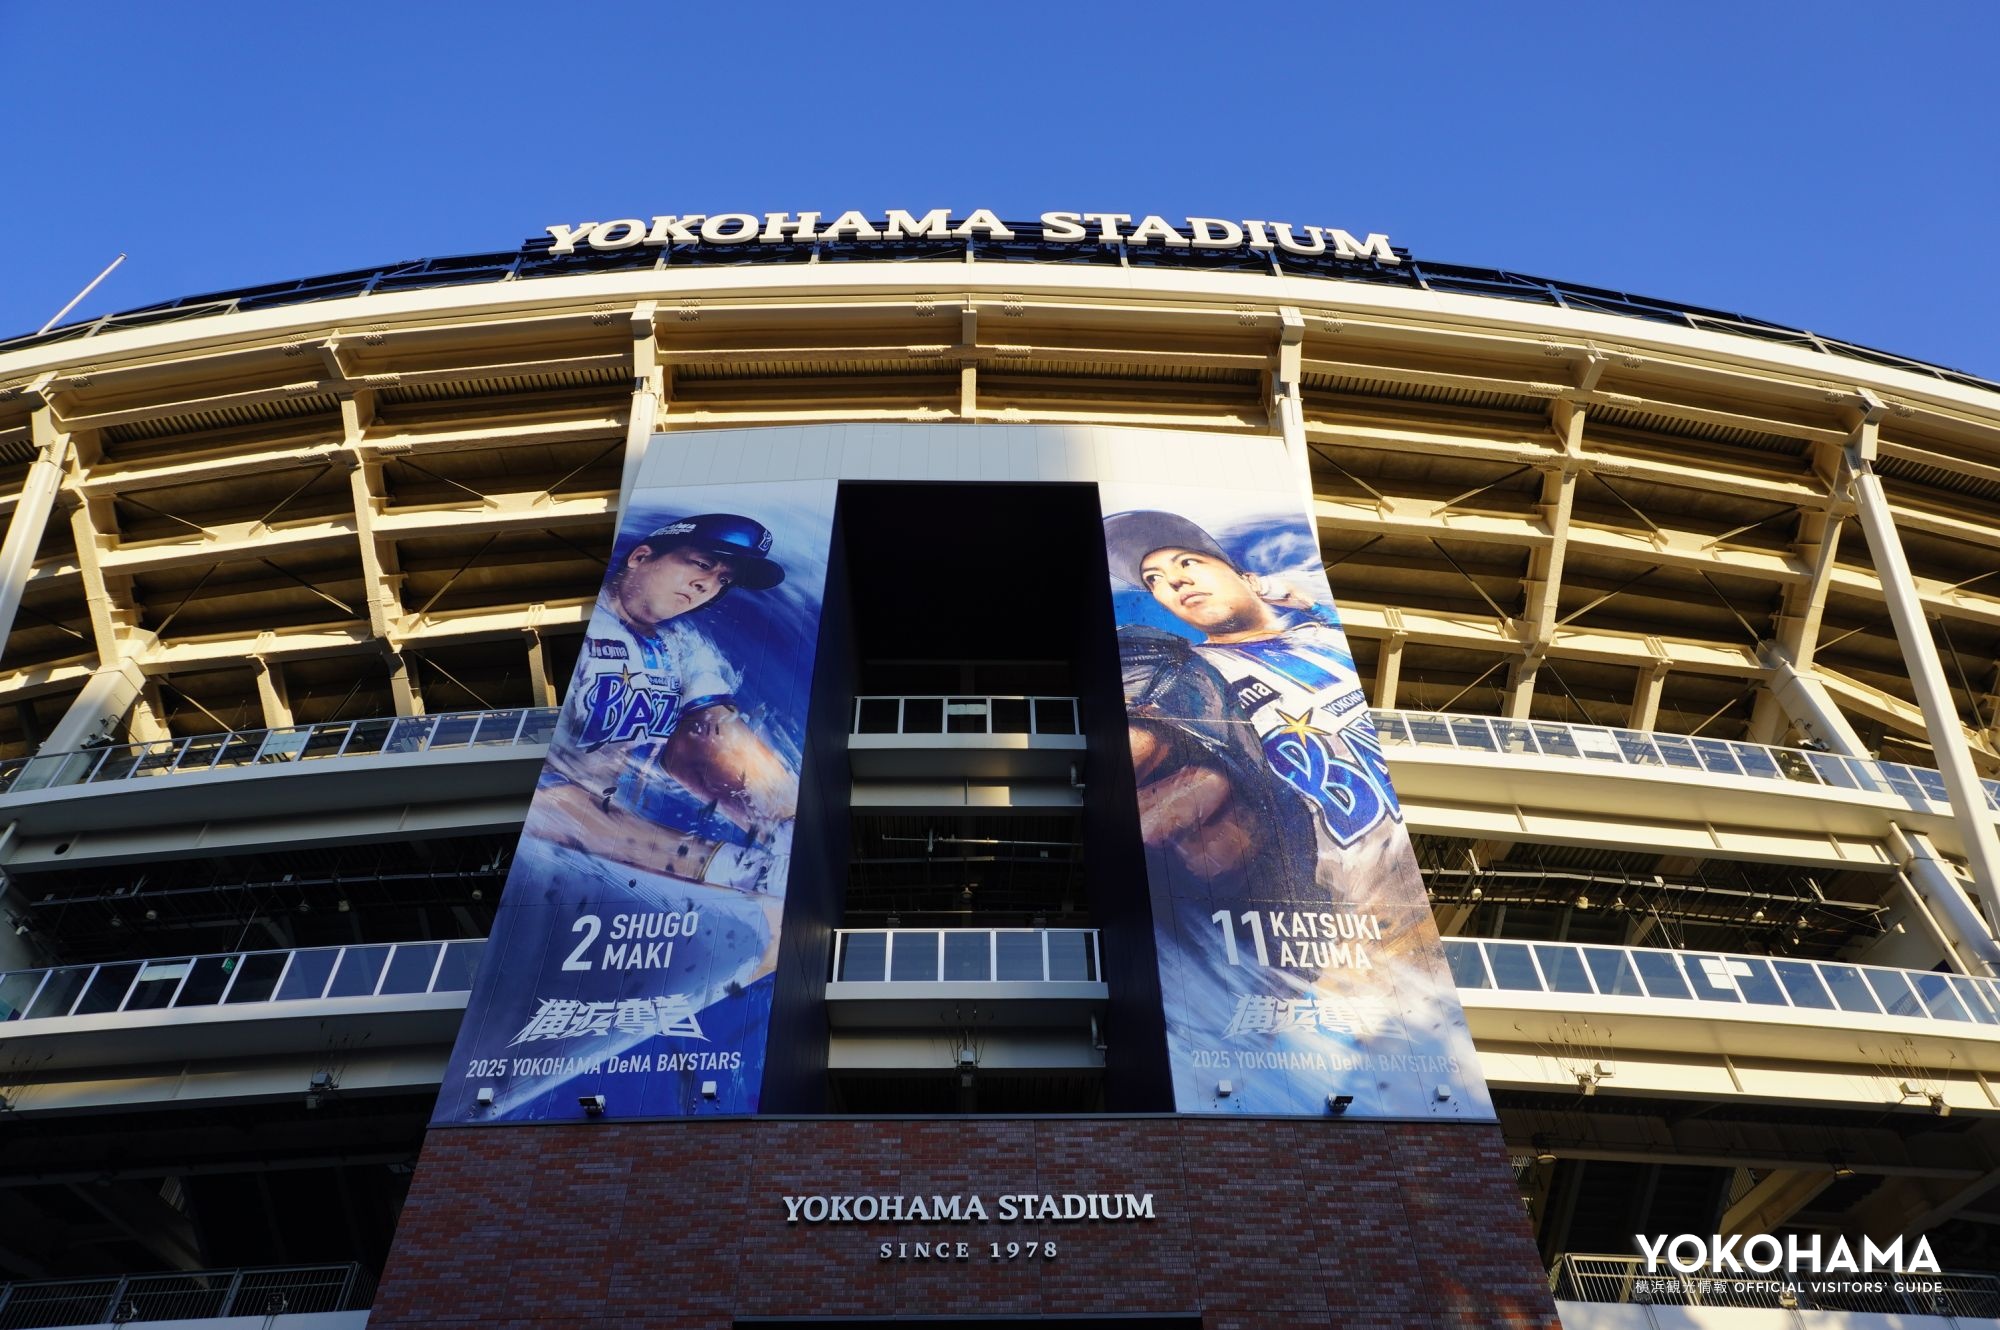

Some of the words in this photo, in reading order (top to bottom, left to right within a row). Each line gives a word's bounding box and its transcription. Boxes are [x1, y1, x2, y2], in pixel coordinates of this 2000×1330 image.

[546, 208, 1015, 255] YOKOHAMA
[1040, 211, 1401, 265] STADIUM
[609, 911, 699, 940] SHUGO
[1212, 909, 1270, 967] 11
[1269, 911, 1382, 941] KATSUKI
[561, 914, 602, 972] 2
[601, 941, 674, 971] MAKI
[1280, 940, 1374, 970] AZUMA
[466, 1057, 507, 1078] 2025
[511, 1055, 602, 1077] YOKOHAMA
[607, 1053, 652, 1074] DeNA
[656, 1051, 742, 1072] BAYSTARS
[1192, 1050, 1231, 1069] 2025
[1235, 1051, 1327, 1071] YOKOHAMA
[1330, 1053, 1376, 1072] DeNA
[1379, 1054, 1460, 1073] BAYSTARS
[783, 1195, 989, 1222] YOKOHAMA
[998, 1193, 1156, 1220] STADIUM
[879, 1242, 969, 1259] SINCE
[990, 1241, 1058, 1259] 1978
